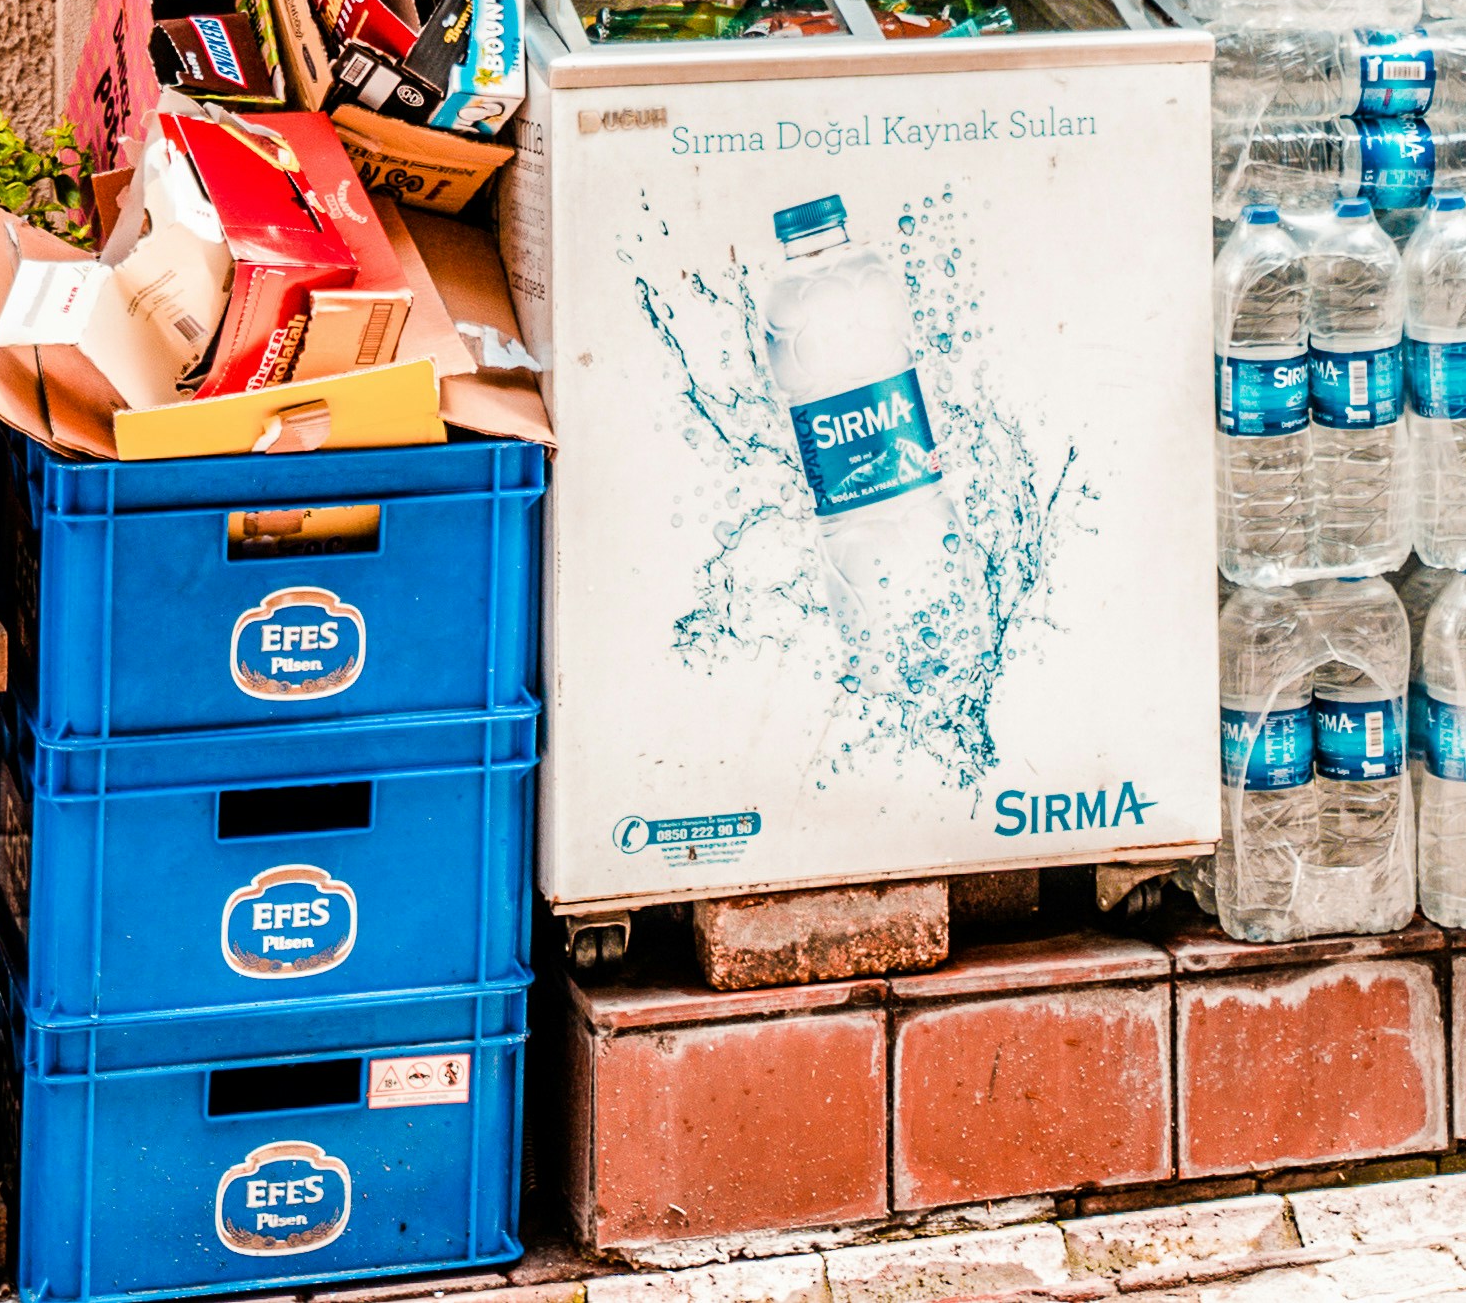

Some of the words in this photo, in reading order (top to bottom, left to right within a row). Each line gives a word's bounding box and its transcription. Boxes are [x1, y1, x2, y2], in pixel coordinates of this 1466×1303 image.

[197, 17, 243, 85] SNICKERS
[671, 124, 765, 156] Sırma
[776, 120, 872, 156] Doğal
[882, 115, 1001, 152] Kaynak
[1009, 110, 1098, 141] Suları
[245, 328, 287, 393] ÜLKER
[812, 392, 915, 449] SIRMA
[260, 621, 339, 652] EFES
[270, 655, 324, 675] Pilsen
[1317, 712, 1358, 734] RMA
[995, 780, 1160, 838] SIRMA
[657, 829, 687, 842] 0850
[691, 826, 714, 838] 222
[718, 825, 733, 836] 90
[250, 899, 331, 931] EFES
[262, 933, 315, 952] Pilsen
[245, 1177, 325, 1208] EFES
[256, 1210, 308, 1229] Pilsen
